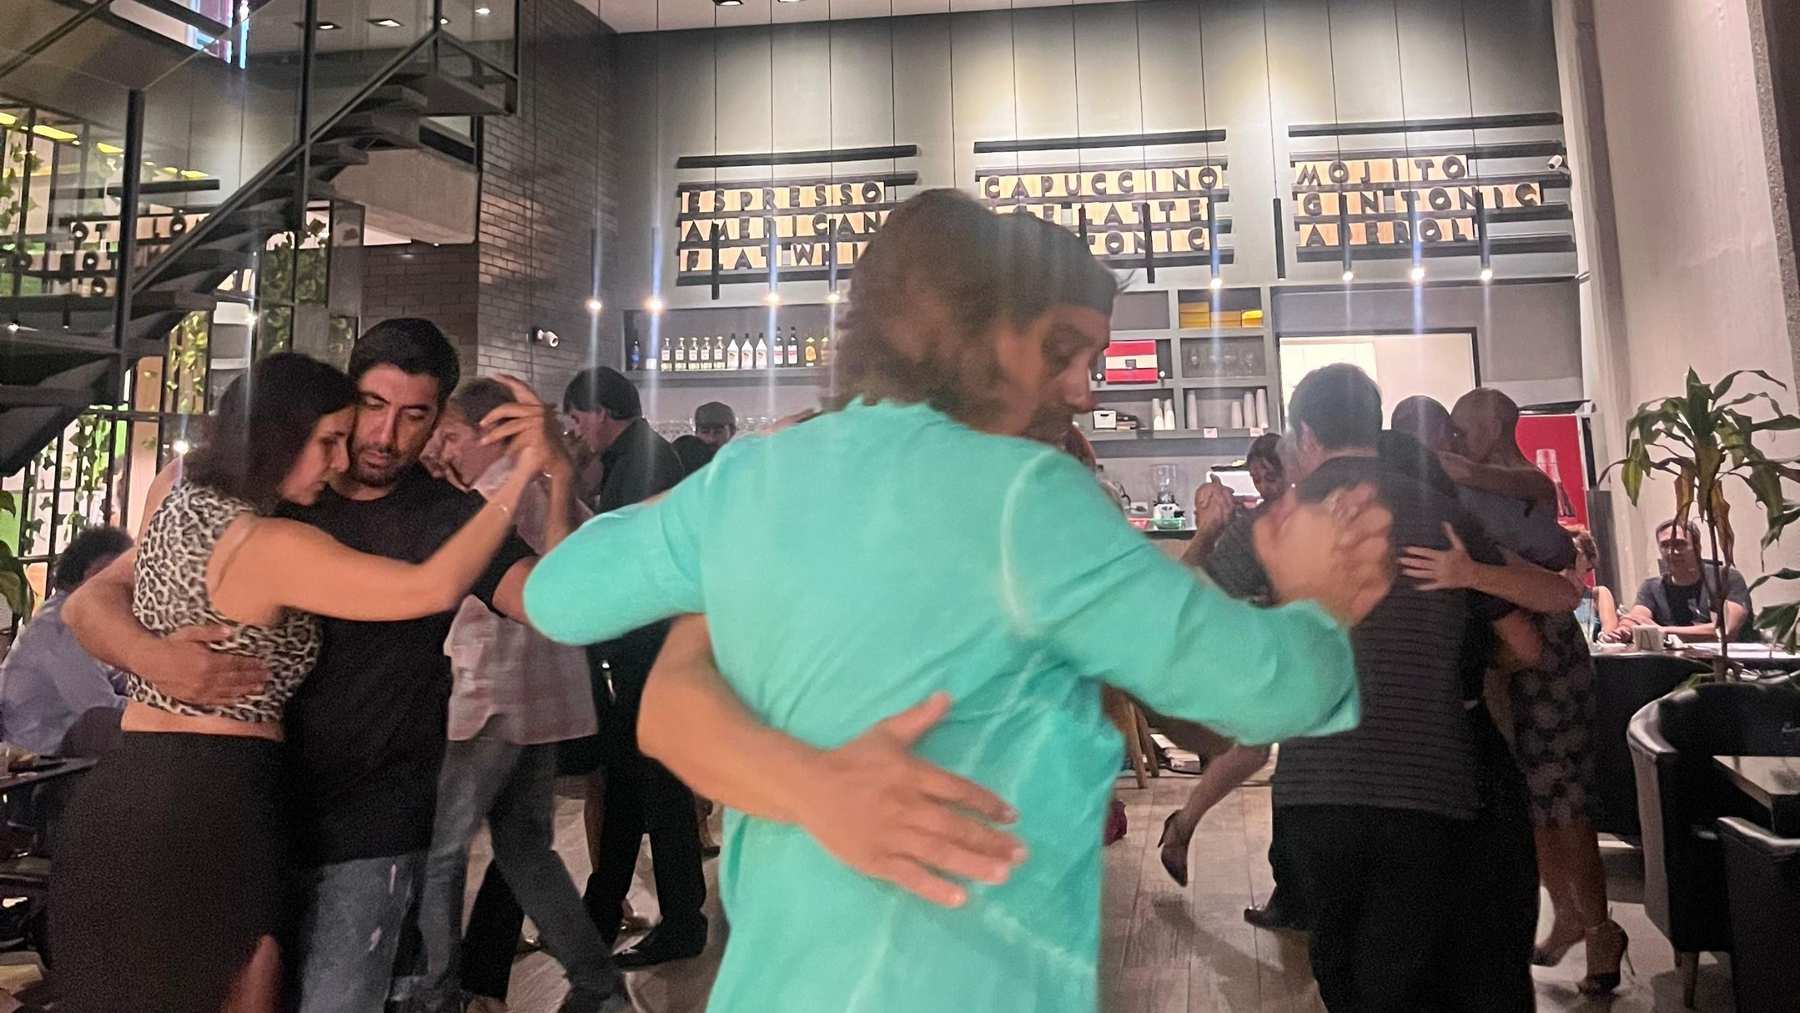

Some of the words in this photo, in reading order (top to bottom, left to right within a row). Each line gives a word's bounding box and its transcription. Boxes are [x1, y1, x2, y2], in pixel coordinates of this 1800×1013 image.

[985, 166, 1217, 199] CAPUCCINO
[1297, 156, 1466, 186] MOJITO
[688, 182, 881, 212] ESPRESSO
[1303, 191, 1378, 216] GN
[1401, 183, 1537, 211] TONIC
[685, 211, 893, 241] AMERICAN
[1080, 200, 1201, 225] ATTE
[1087, 227, 1205, 255] ONIC
